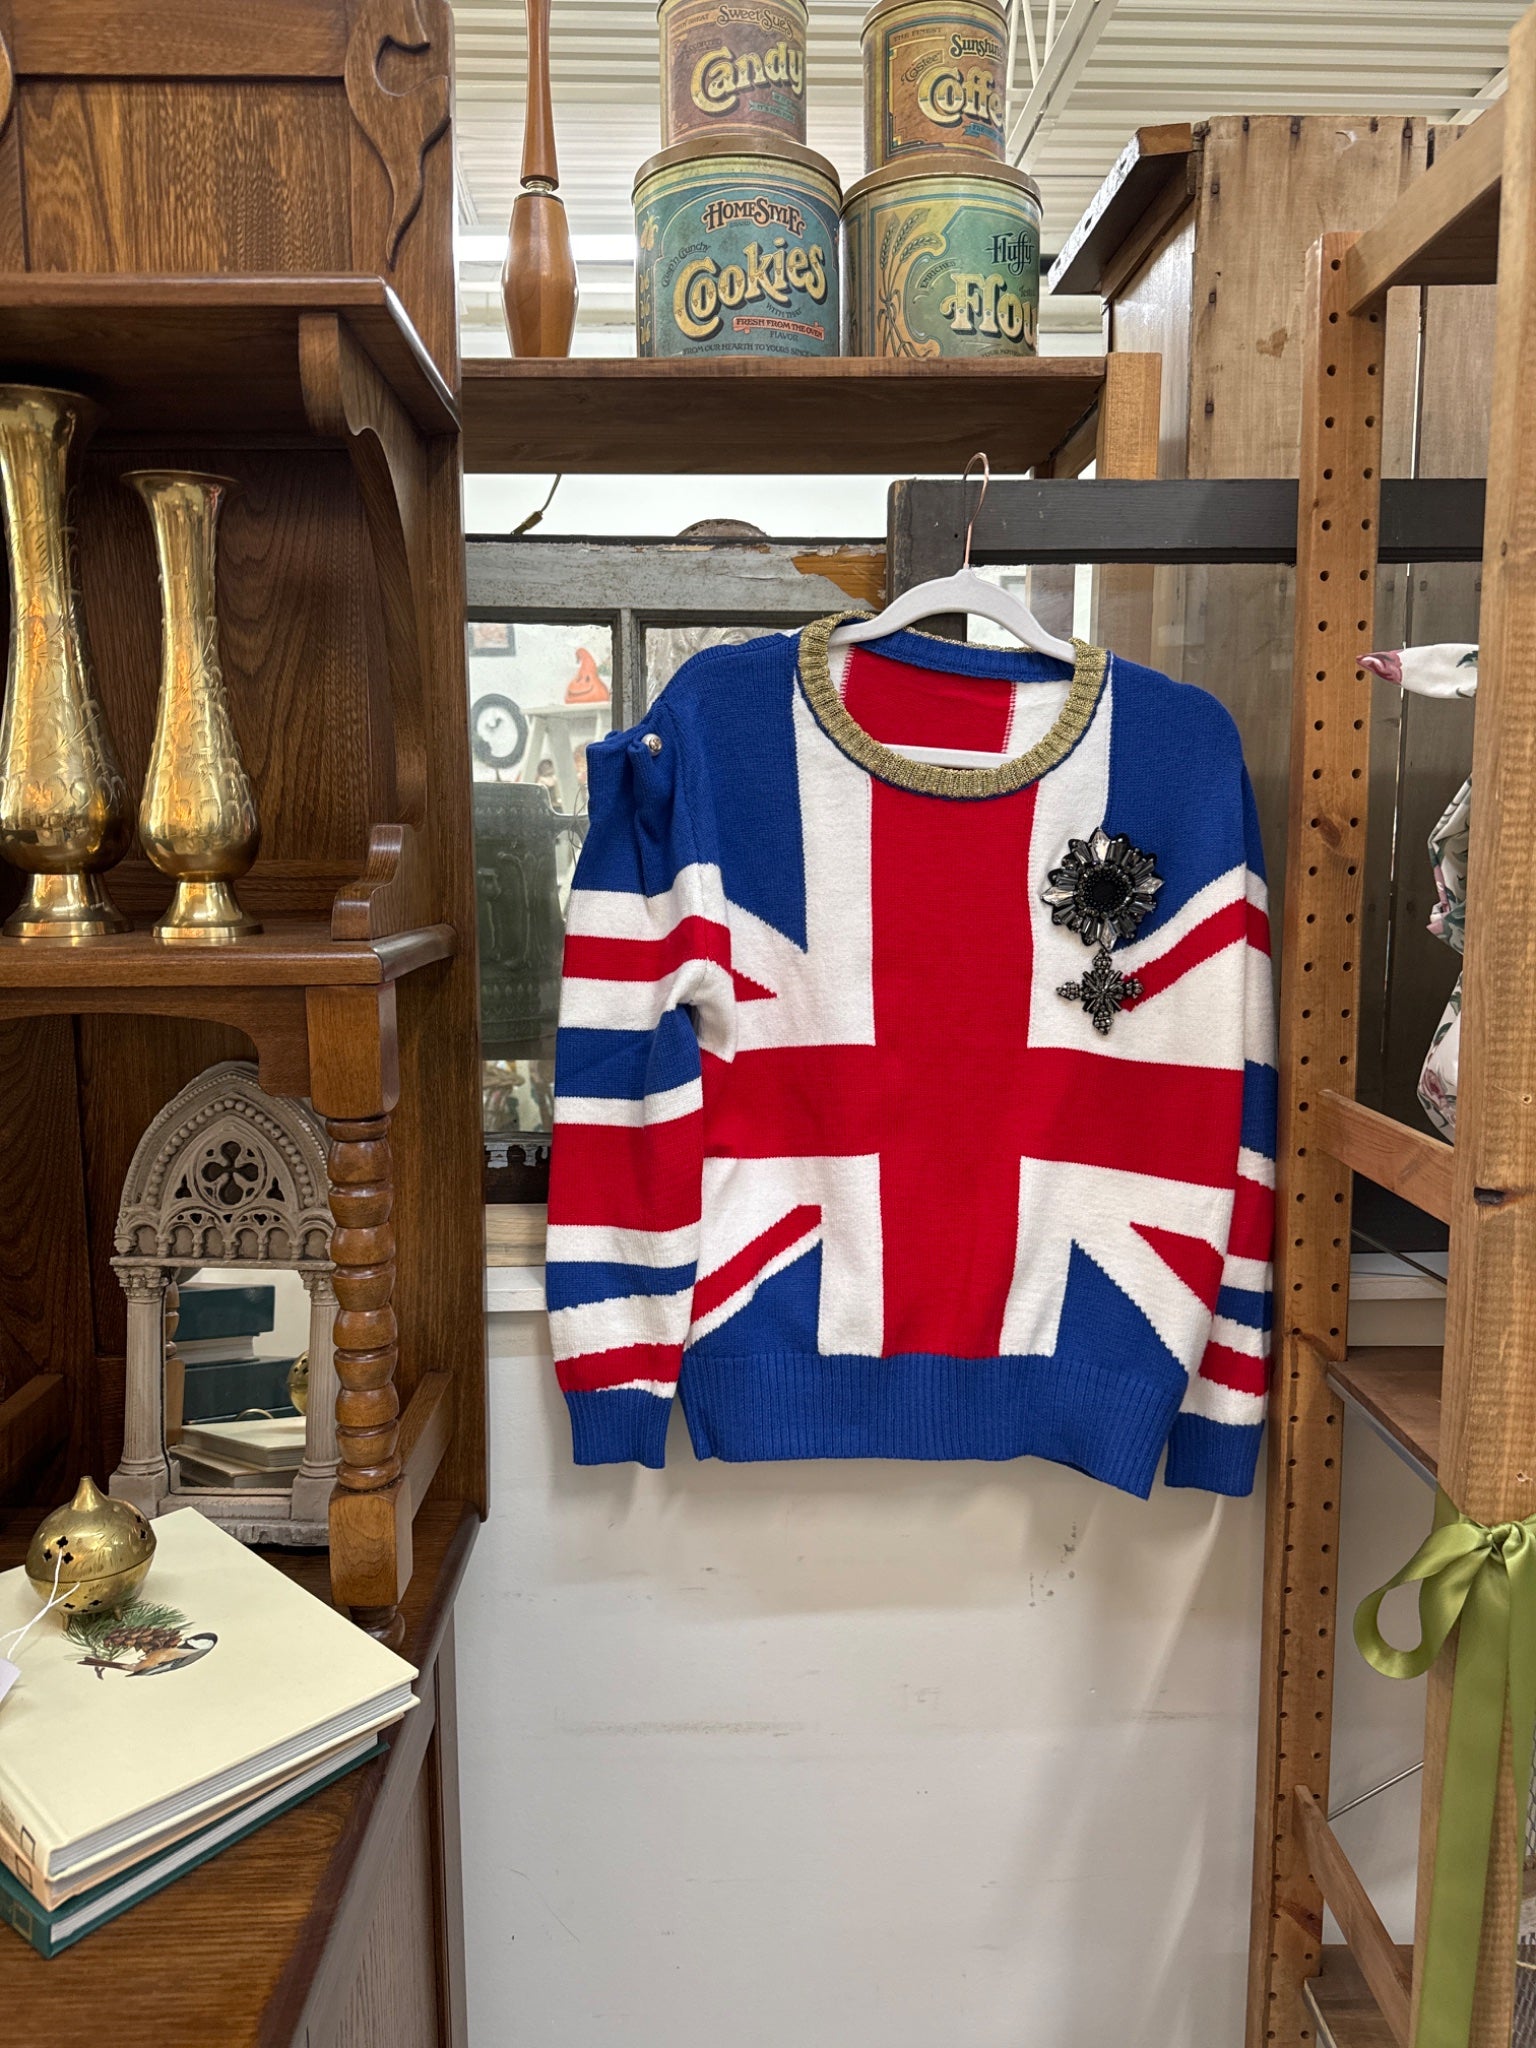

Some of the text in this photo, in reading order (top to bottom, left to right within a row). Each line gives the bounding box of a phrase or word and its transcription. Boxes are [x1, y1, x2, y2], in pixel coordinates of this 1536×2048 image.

[717, 5, 760, 26] Sweet
[690, 42, 804, 116] Candy
[920, 258, 956, 289] ENRICHED
[673, 237, 827, 342] Cookies
[736, 318, 823, 339] FRESH FROM THE OVEN
[770, 330, 799, 341] FLAVOR
[683, 344, 704, 355] FROM
[704, 343, 720, 352] OUR
[721, 342, 753, 351] HEARTH
[754, 343, 766, 351] TO
